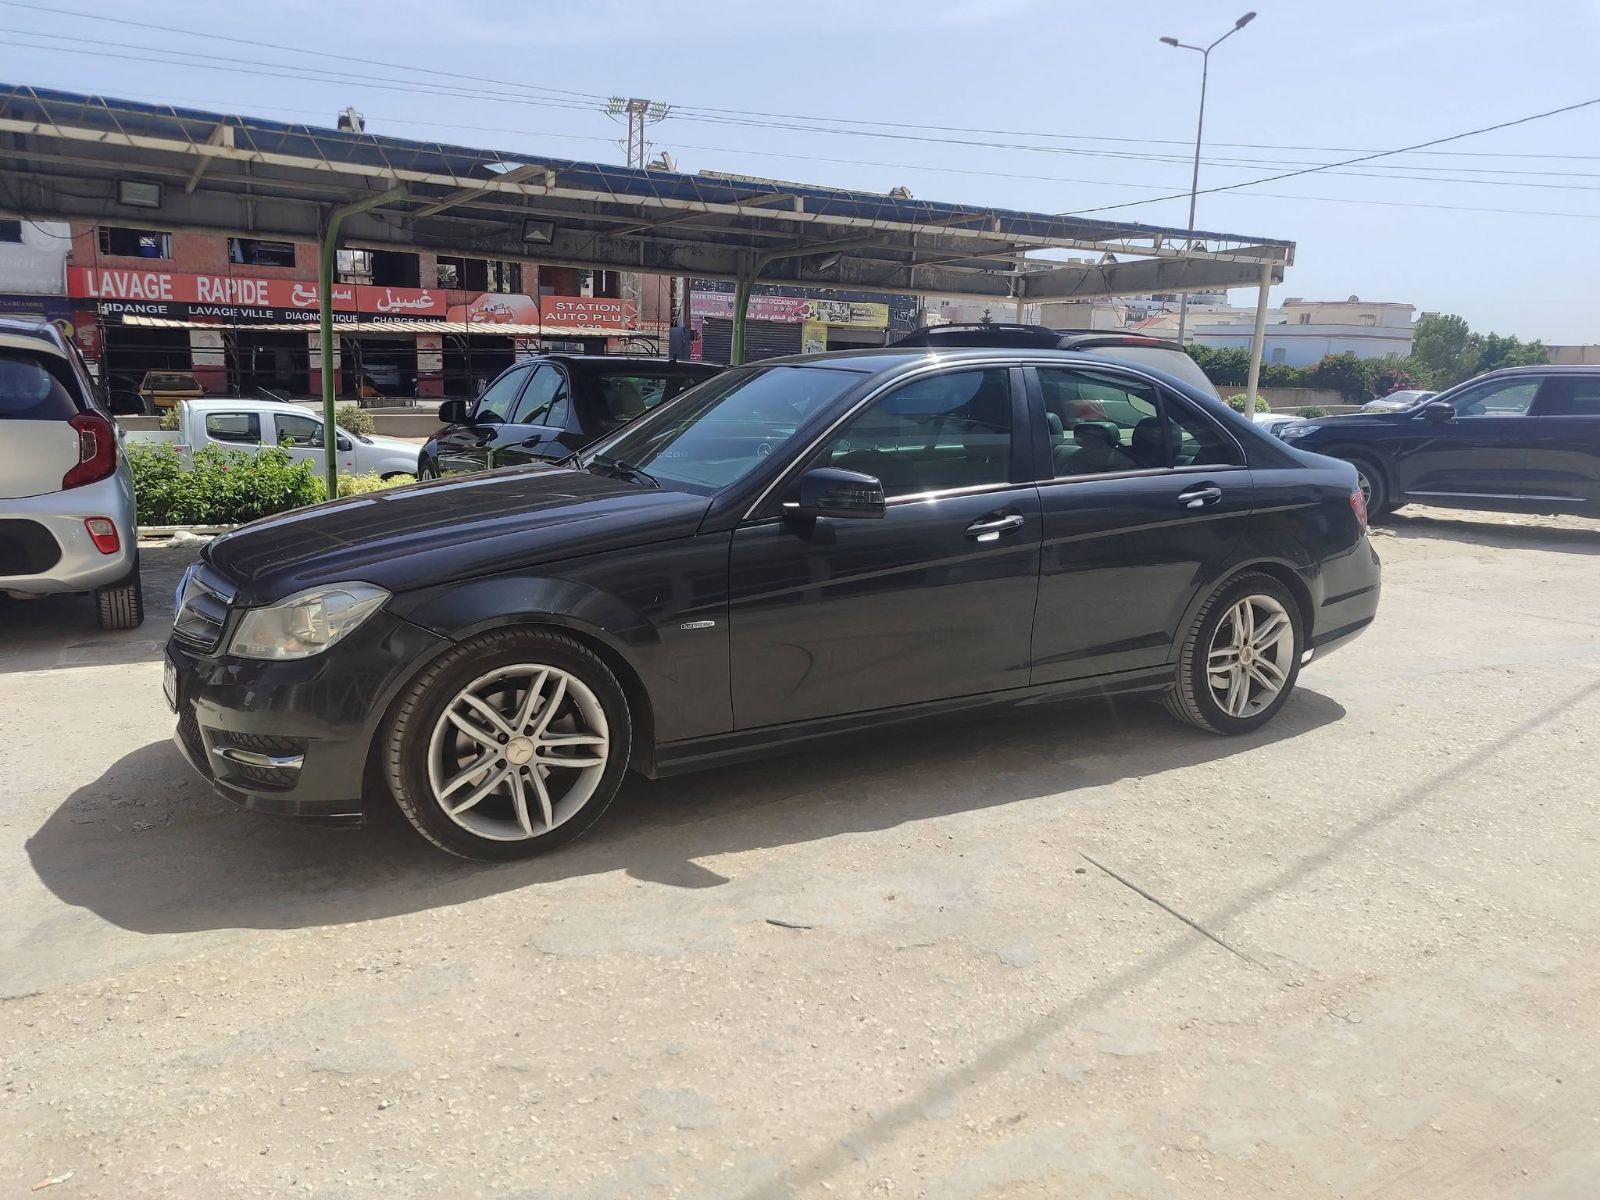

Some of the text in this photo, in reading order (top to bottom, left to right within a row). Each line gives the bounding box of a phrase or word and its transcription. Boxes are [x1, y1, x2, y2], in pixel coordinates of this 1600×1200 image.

[87, 270, 269, 305] LAVAGE RAPIDE
[292, 283, 435, 312] غسيل سيع
[188, 306, 237, 317] LAVAGE
[240, 308, 274, 319] VILLE
[285, 311, 358, 323] DIAGNOTIQUE
[556, 302, 621, 312] STATION
[545, 313, 588, 321] AUTO
